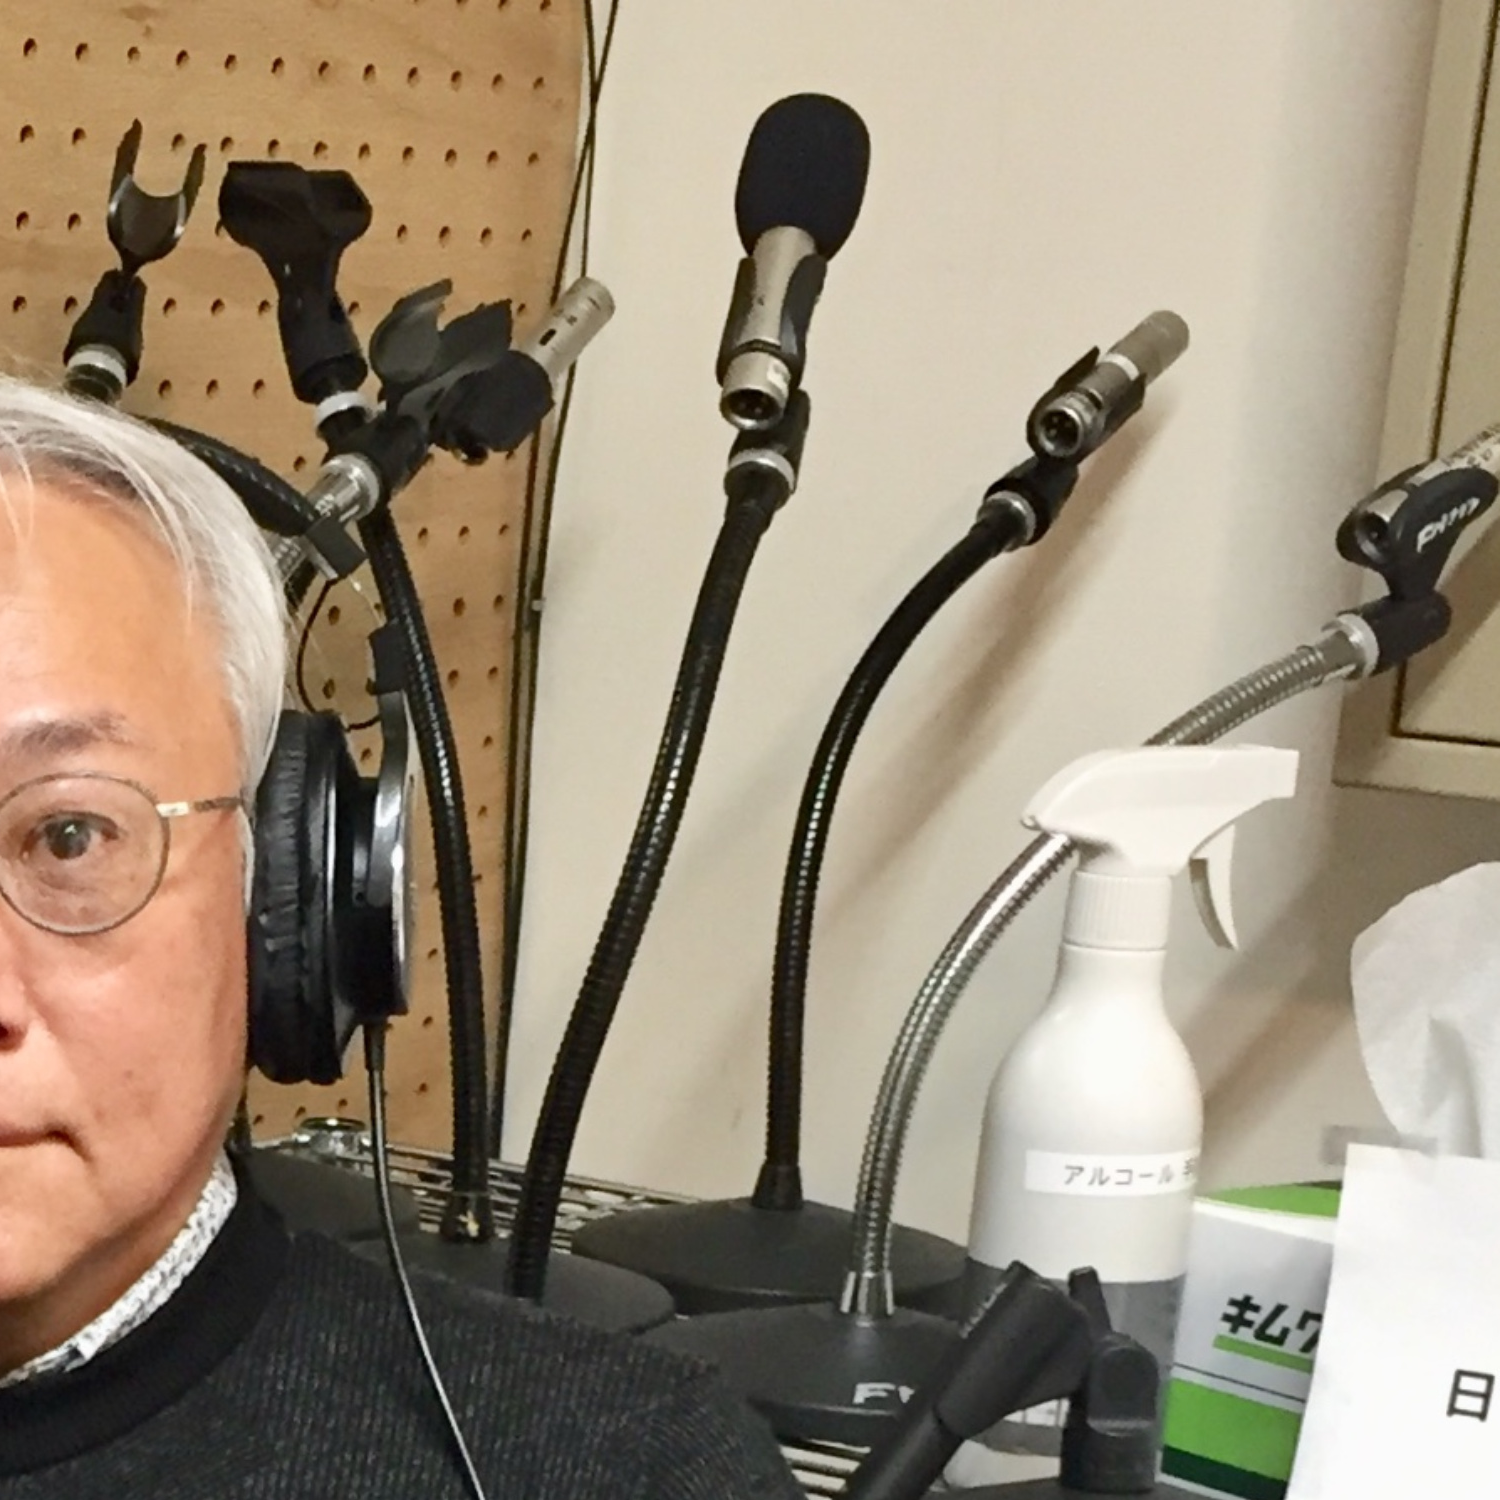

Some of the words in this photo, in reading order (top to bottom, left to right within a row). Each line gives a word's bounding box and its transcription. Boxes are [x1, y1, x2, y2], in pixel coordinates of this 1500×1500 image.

[1064, 1165, 1175, 1186] アルコール
[1446, 1369, 1495, 1422] 日
